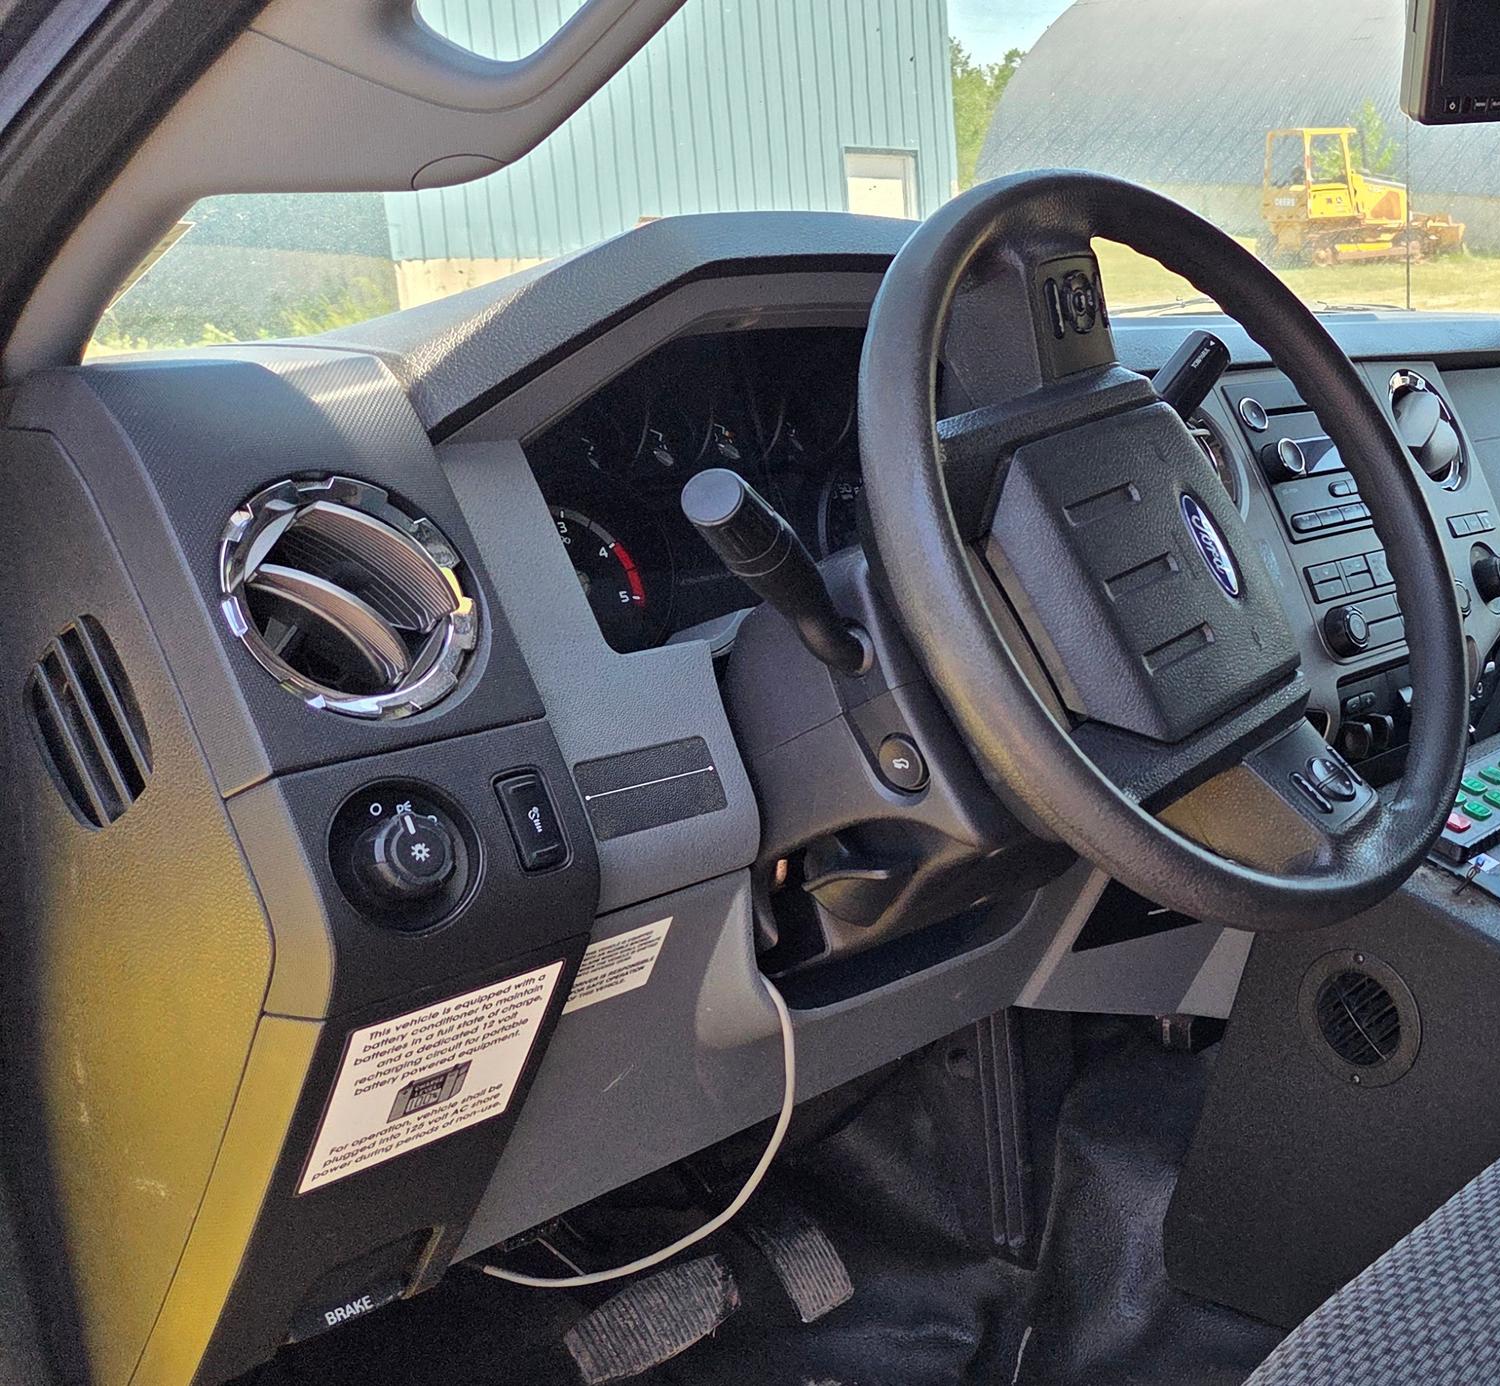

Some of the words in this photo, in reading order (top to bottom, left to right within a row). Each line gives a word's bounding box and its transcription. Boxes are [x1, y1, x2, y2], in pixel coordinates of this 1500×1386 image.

[557, 521, 568, 533] 3
[599, 546, 608, 558] 4
[618, 590, 630, 603] 5
[353, 1042, 408, 1066] batteries
[410, 1037, 422, 1047] in
[424, 1032, 435, 1041] a
[436, 1024, 455, 1037] full
[456, 1015, 485, 1030] state
[487, 1007, 501, 1019] of
[362, 1032, 408, 1053] battery
[410, 1007, 480, 1036] conditioner
[481, 999, 493, 1011] to
[495, 984, 543, 1007] maintain
[369, 1027, 391, 1041] This
[395, 1011, 440, 1031] vehicle
[441, 1006, 452, 1016] is
[454, 985, 512, 1011] equipped
[514, 977, 536, 990] with
[537, 973, 546, 982] a
[354, 1056, 423, 1086] recharging
[425, 1040, 463, 1060] circuit
[464, 1035, 481, 1046] for
[481, 1018, 529, 1041] portable
[376, 1052, 403, 1068] and
[404, 1050, 414, 1058] a
[416, 1025, 479, 1054] dedicated
[482, 1019, 496, 1031] 12
[497, 1010, 519, 1025] volt
[354, 1075, 399, 1096] battery
[400, 1052, 456, 1081] powered
[322, 1140, 377, 1168] plugged
[378, 1132, 401, 1145] into
[405, 1121, 425, 1135] 125
[428, 1112, 449, 1126] volt
[450, 1104, 469, 1117] AC
[470, 1092, 501, 1108] shore
[328, 1143, 349, 1156] For
[416, 1101, 458, 1121] vehicle
[460, 1088, 487, 1104] shall
[487, 1083, 503, 1093] be
[311, 1156, 353, 1182] power
[354, 1143, 394, 1163] during
[394, 1125, 439, 1149] periods
[441, 1118, 455, 1129] of
[324, 1295, 374, 1326] BRAKE
